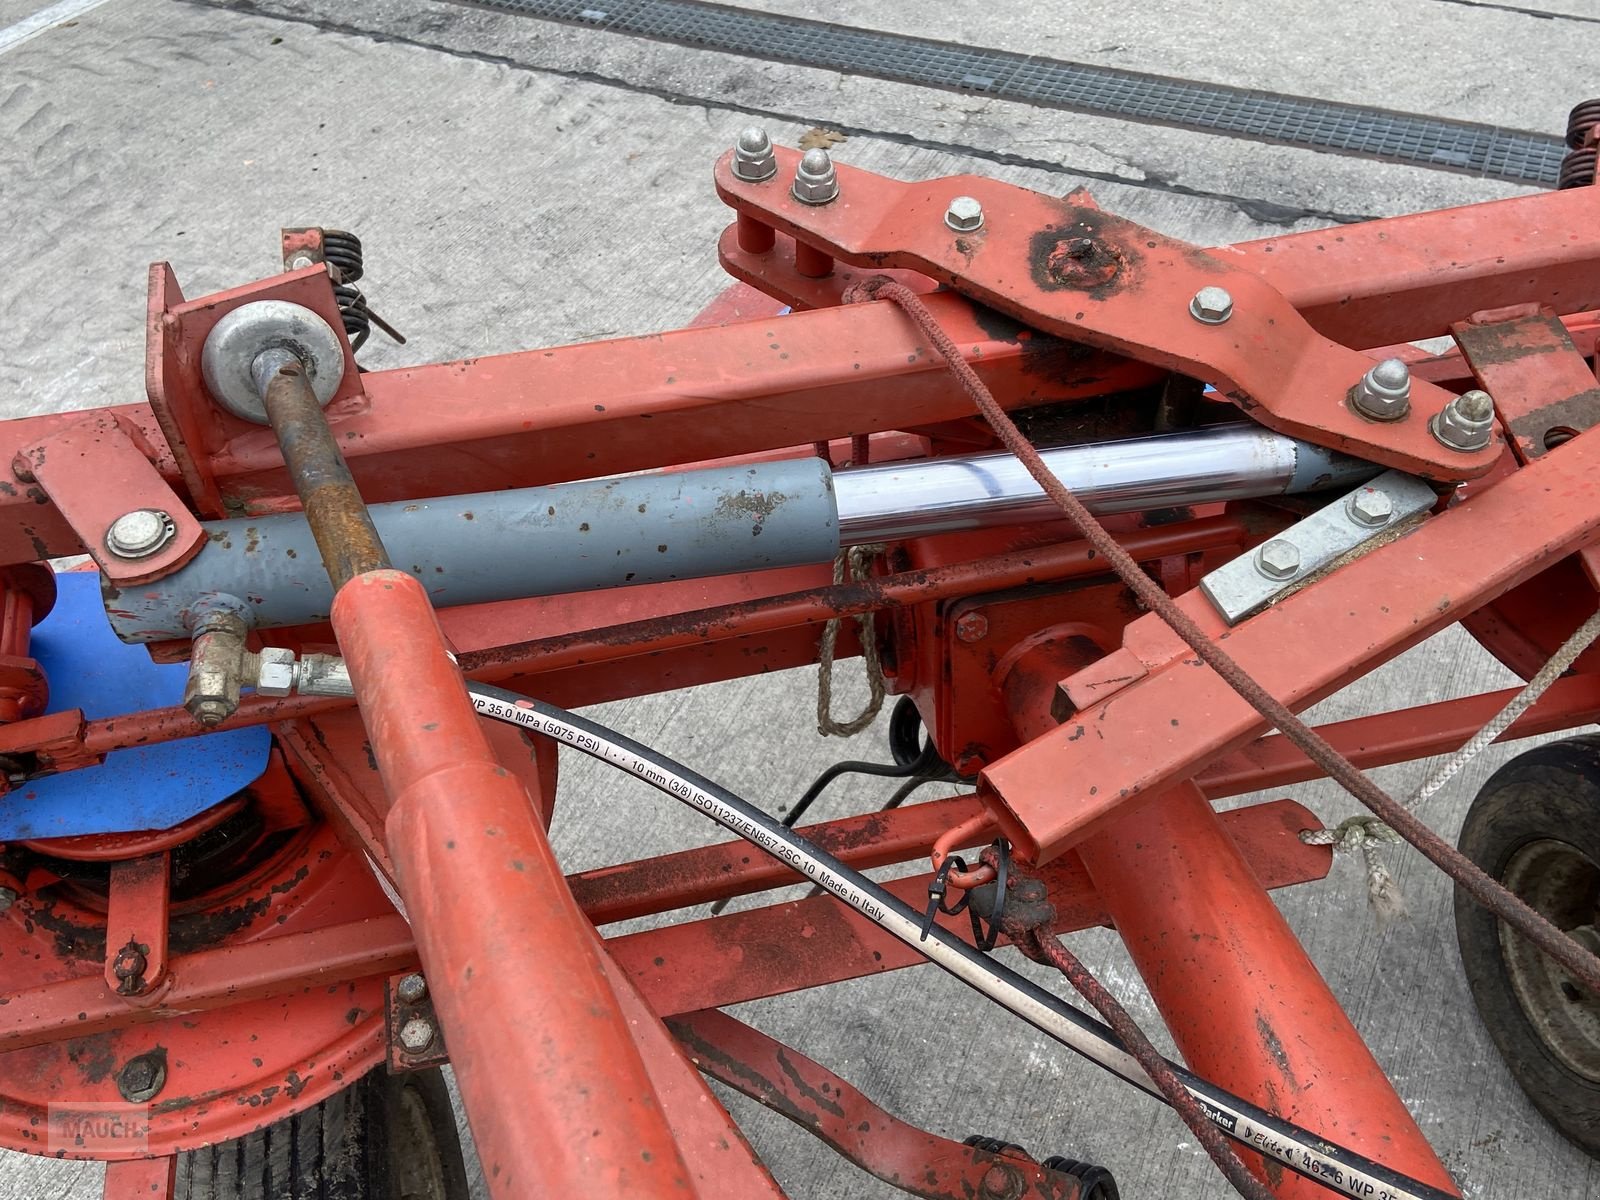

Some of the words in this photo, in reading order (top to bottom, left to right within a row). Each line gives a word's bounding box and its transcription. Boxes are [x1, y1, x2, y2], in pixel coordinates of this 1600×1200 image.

[488, 703, 513, 718] 35,0
[516, 711, 540, 728] MPa
[543, 720, 575, 740] (5075
[577, 735, 600, 752] PSI)
[632, 760, 645, 773] 10
[646, 768, 666, 785] mm
[668, 779, 692, 799] (3/8)
[693, 793, 778, 849] ISO11237/EN857
[778, 845, 801, 865] 2SC
[803, 861, 816, 875] 10
[820, 871, 848, 897] Made
[850, 890, 860, 905] in
[861, 899, 885, 921] Italy
[1253, 1132, 1283, 1155] Elite
[1349, 1175, 1374, 1197] WP
